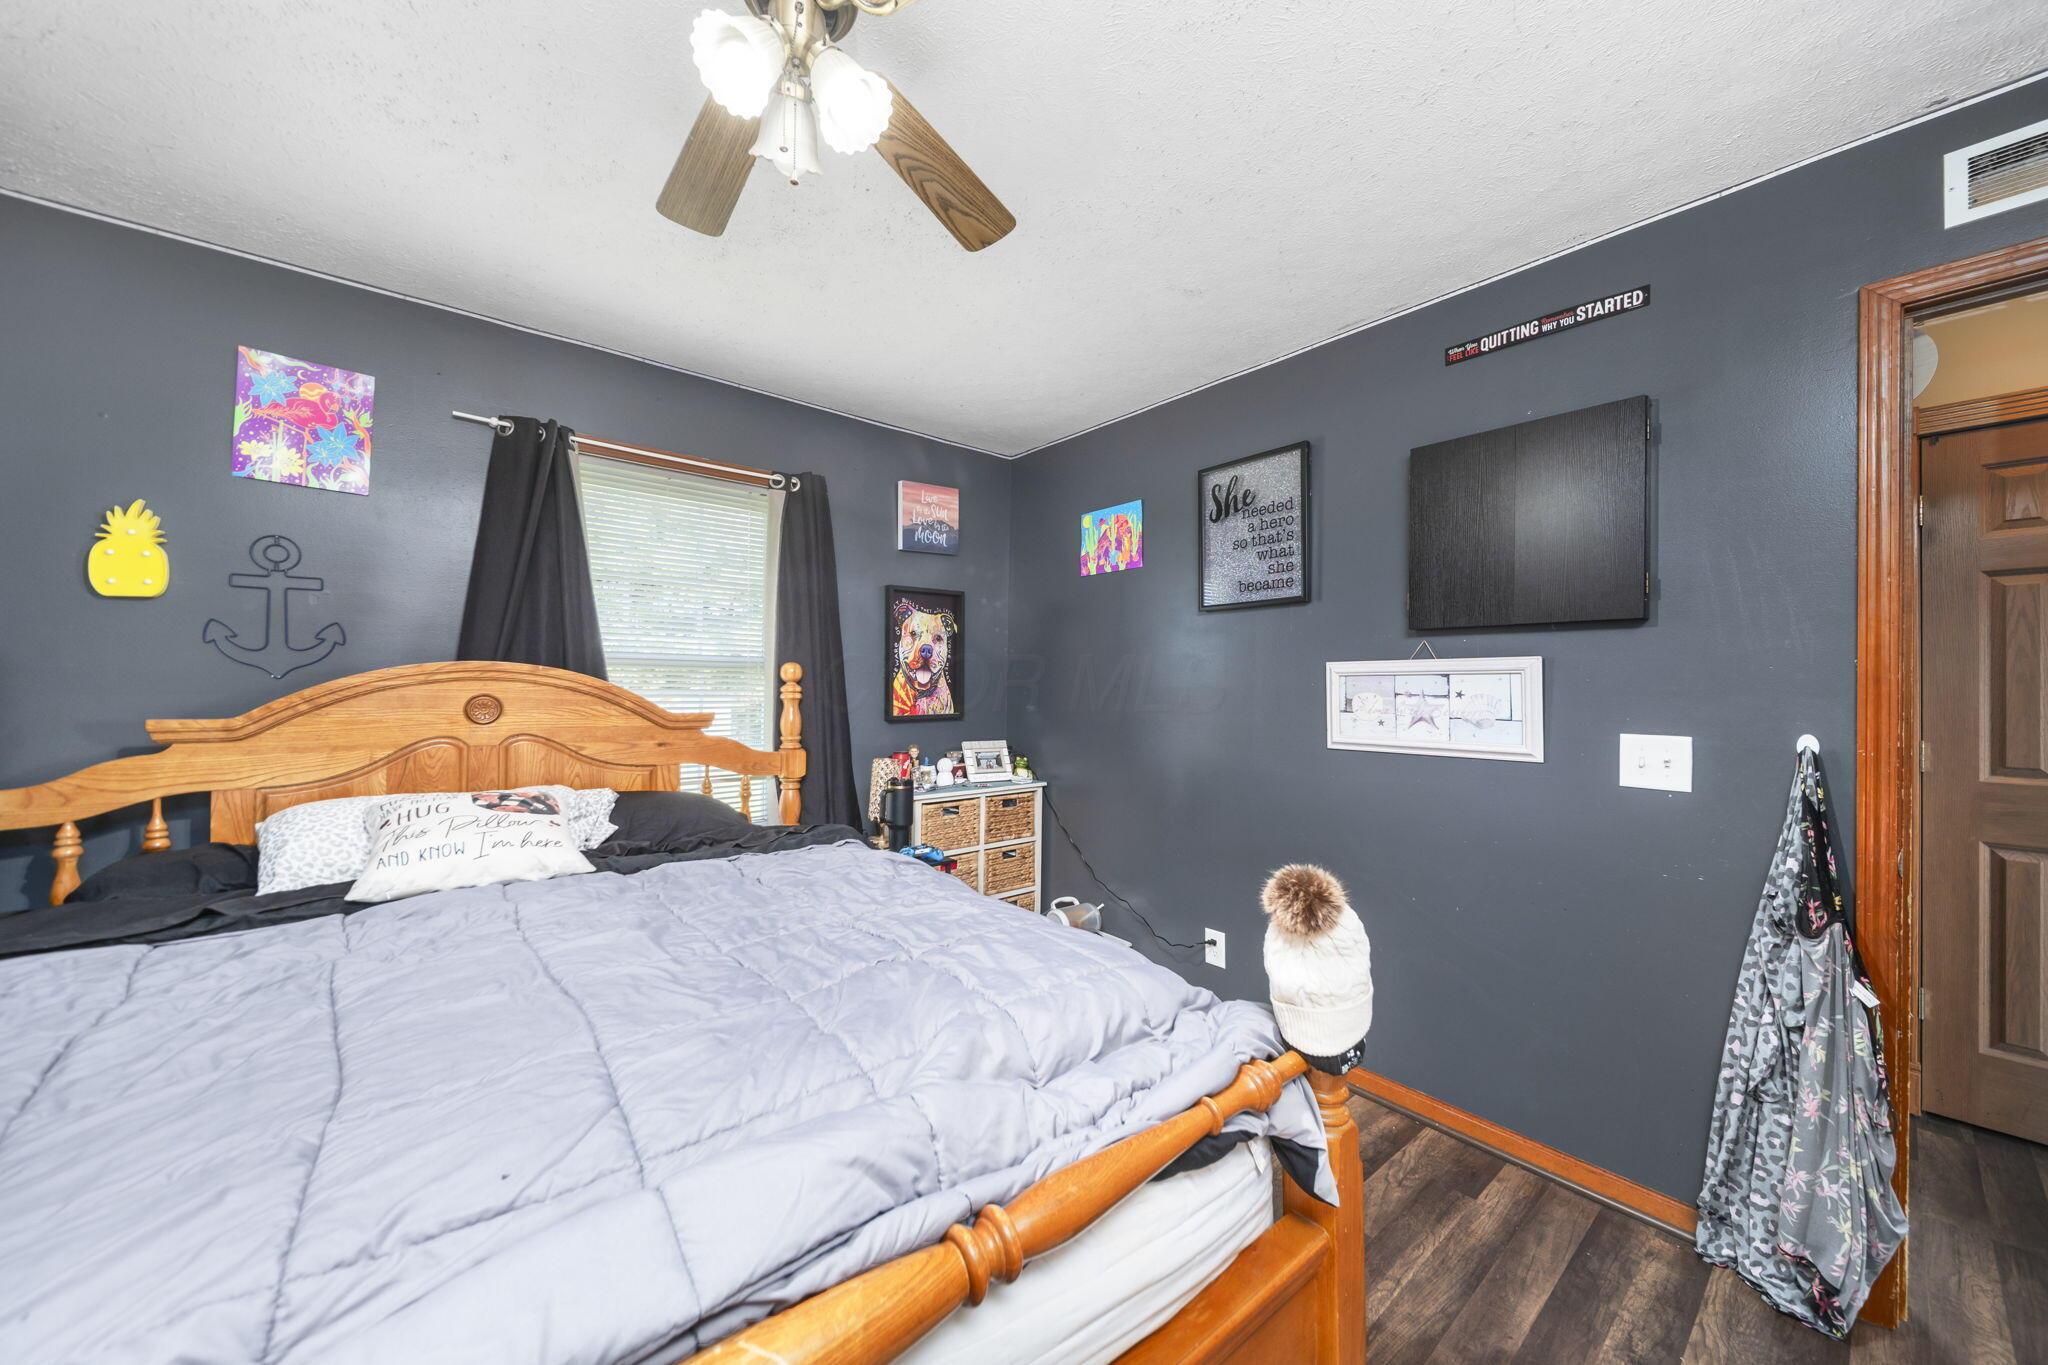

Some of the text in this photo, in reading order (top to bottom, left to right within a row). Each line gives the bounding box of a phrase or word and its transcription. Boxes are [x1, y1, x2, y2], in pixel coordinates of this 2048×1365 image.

[1576, 290, 1644, 321] STARTED
[1541, 316, 1575, 333] WHY YOU
[1480, 320, 1539, 352] QUITTING
[1449, 347, 1479, 362] FEEL LIKE
[1209, 475, 1256, 524] She
[1241, 497, 1295, 519] needed
[1247, 515, 1295, 533] a hero
[1232, 529, 1295, 551] so that's
[1257, 545, 1295, 561] what
[1268, 561, 1294, 574] she
[1238, 576, 1294, 593] became
[397, 801, 450, 826] HUG
[438, 813, 541, 838] Pillow
[376, 830, 564, 870] AND KNOW I'm here
